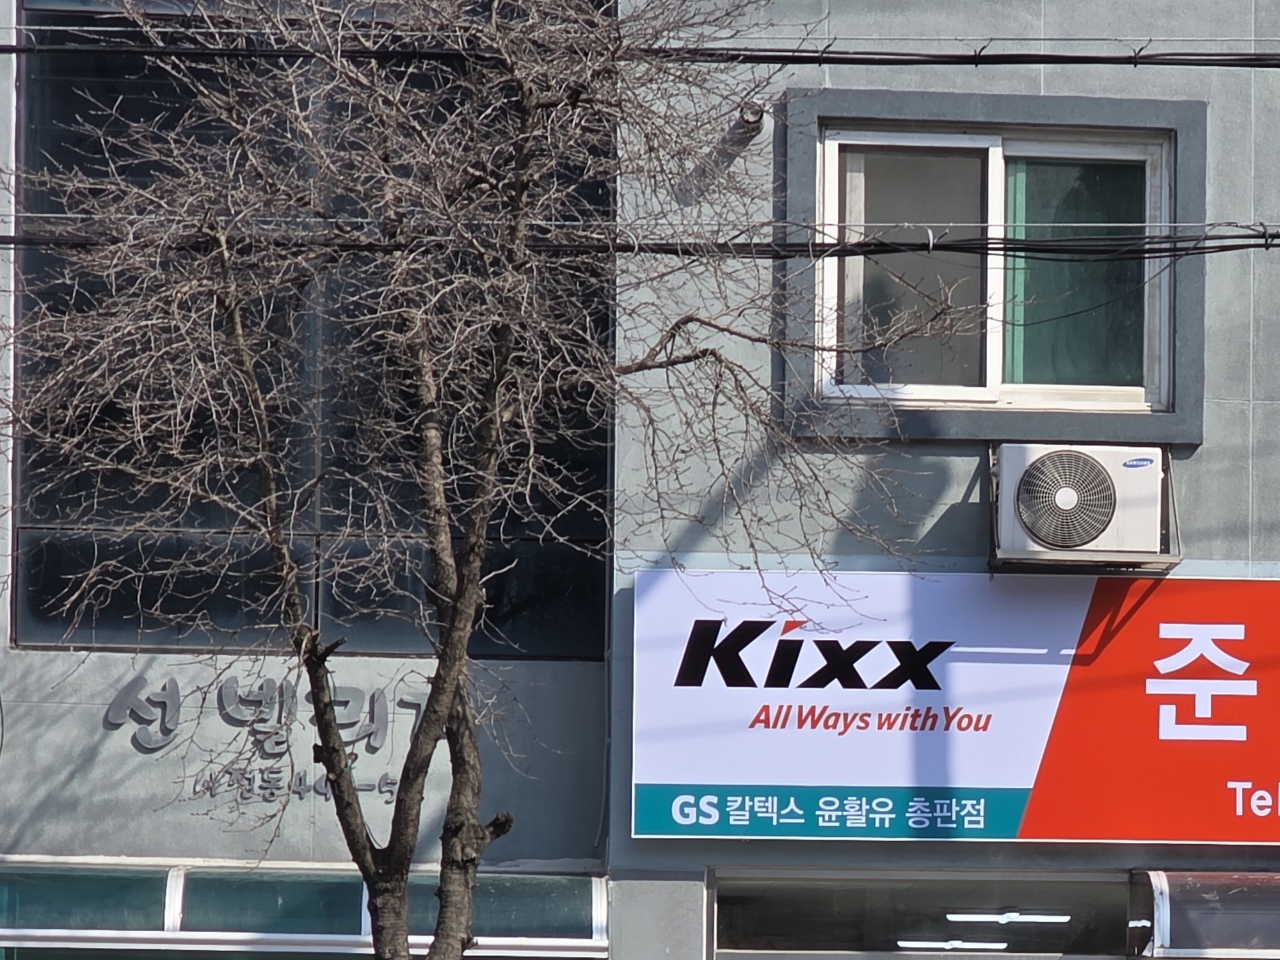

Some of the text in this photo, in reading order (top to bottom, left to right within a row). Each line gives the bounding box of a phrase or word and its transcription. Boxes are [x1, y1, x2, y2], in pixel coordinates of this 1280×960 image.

[674, 620, 956, 690] Kixx
[102, 676, 432, 755] 선빌리
[748, 705, 992, 735] All Ways with You
[671, 795, 985, 829] GS 칼텍스 윤활유 총판점
